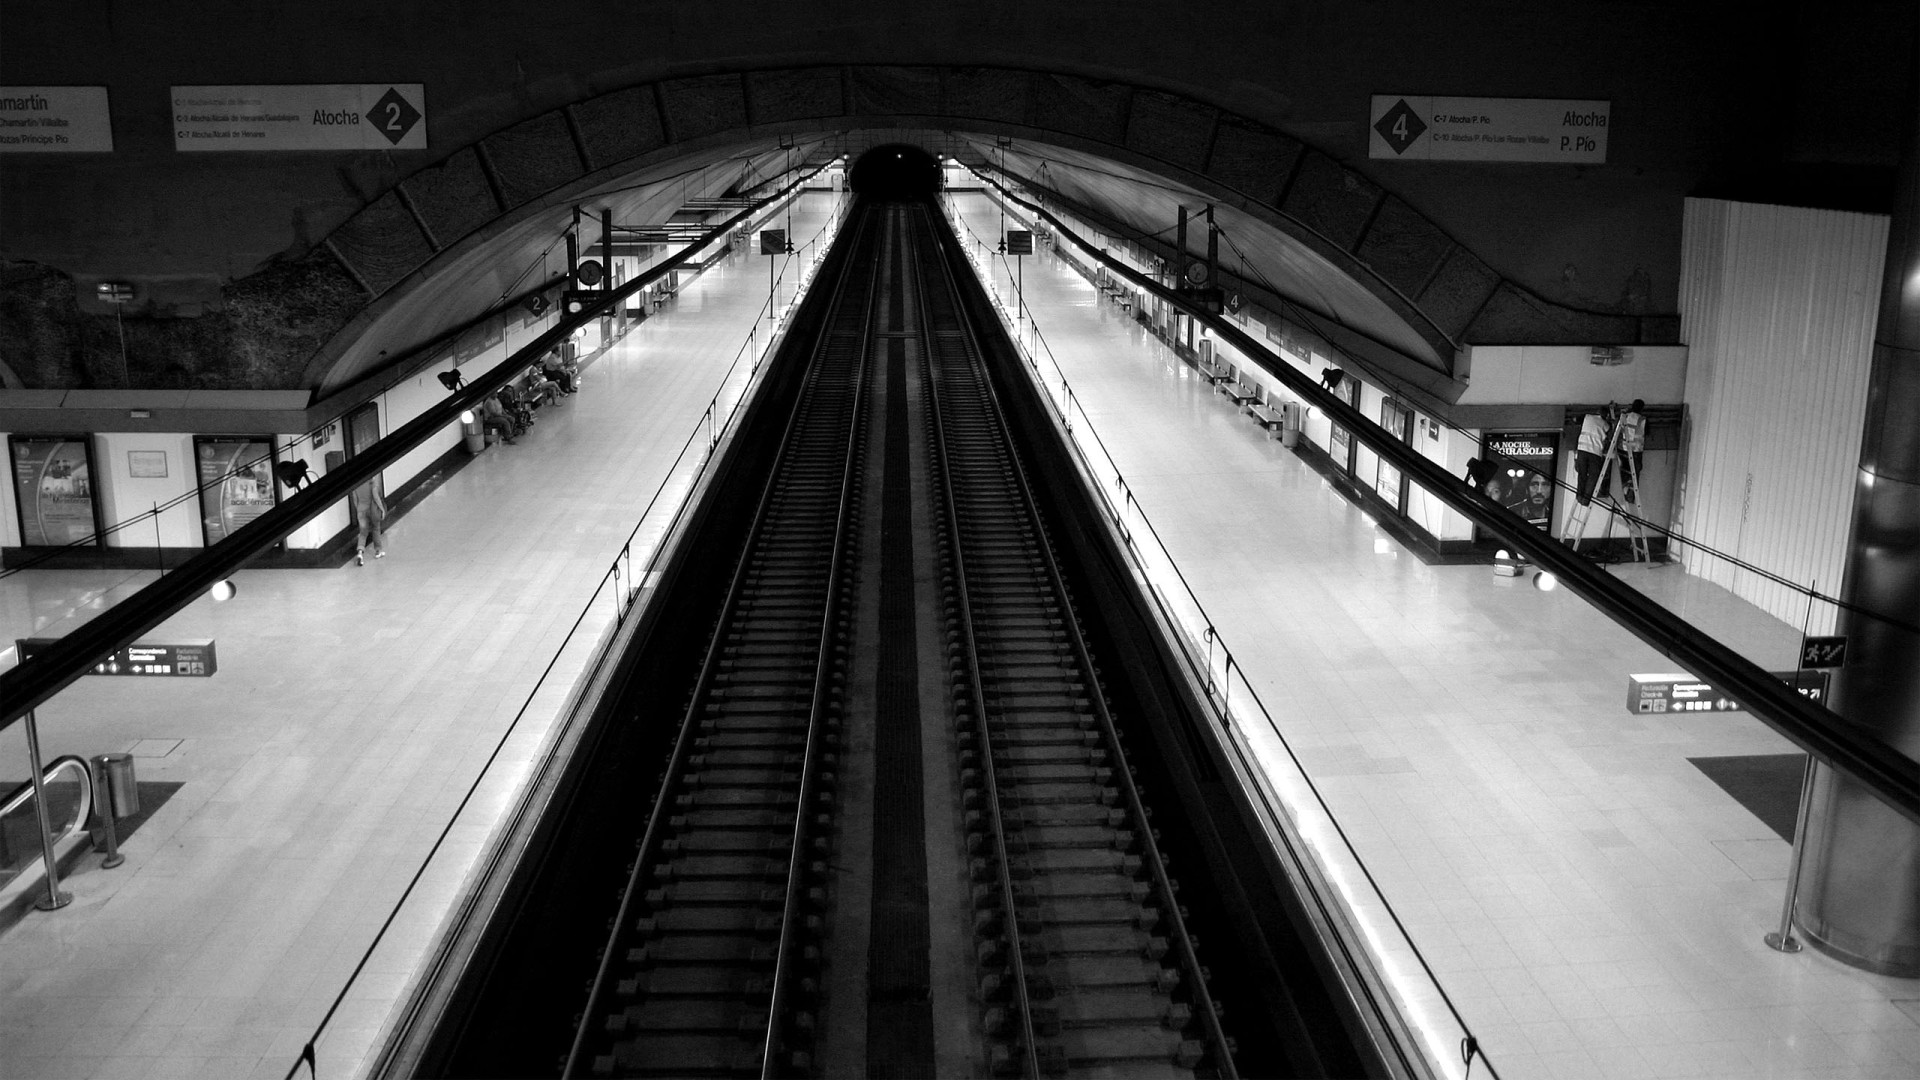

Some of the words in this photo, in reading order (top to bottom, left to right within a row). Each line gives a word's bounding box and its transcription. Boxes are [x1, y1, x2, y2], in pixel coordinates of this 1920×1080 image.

[313, 109, 360, 126] Atocha
[385, 102, 402, 131] 2
[1433, 114, 1447, 124] C-7
[1562, 111, 1607, 127] Atocha
[1392, 113, 1409, 141] 4
[1560, 136, 1572, 152] P.
[1576, 135, 1596, 152] Pío
[532, 296, 541, 311] 2
[1230, 294, 1239, 309] 4
[1502, 441, 1531, 449] NOCHE
